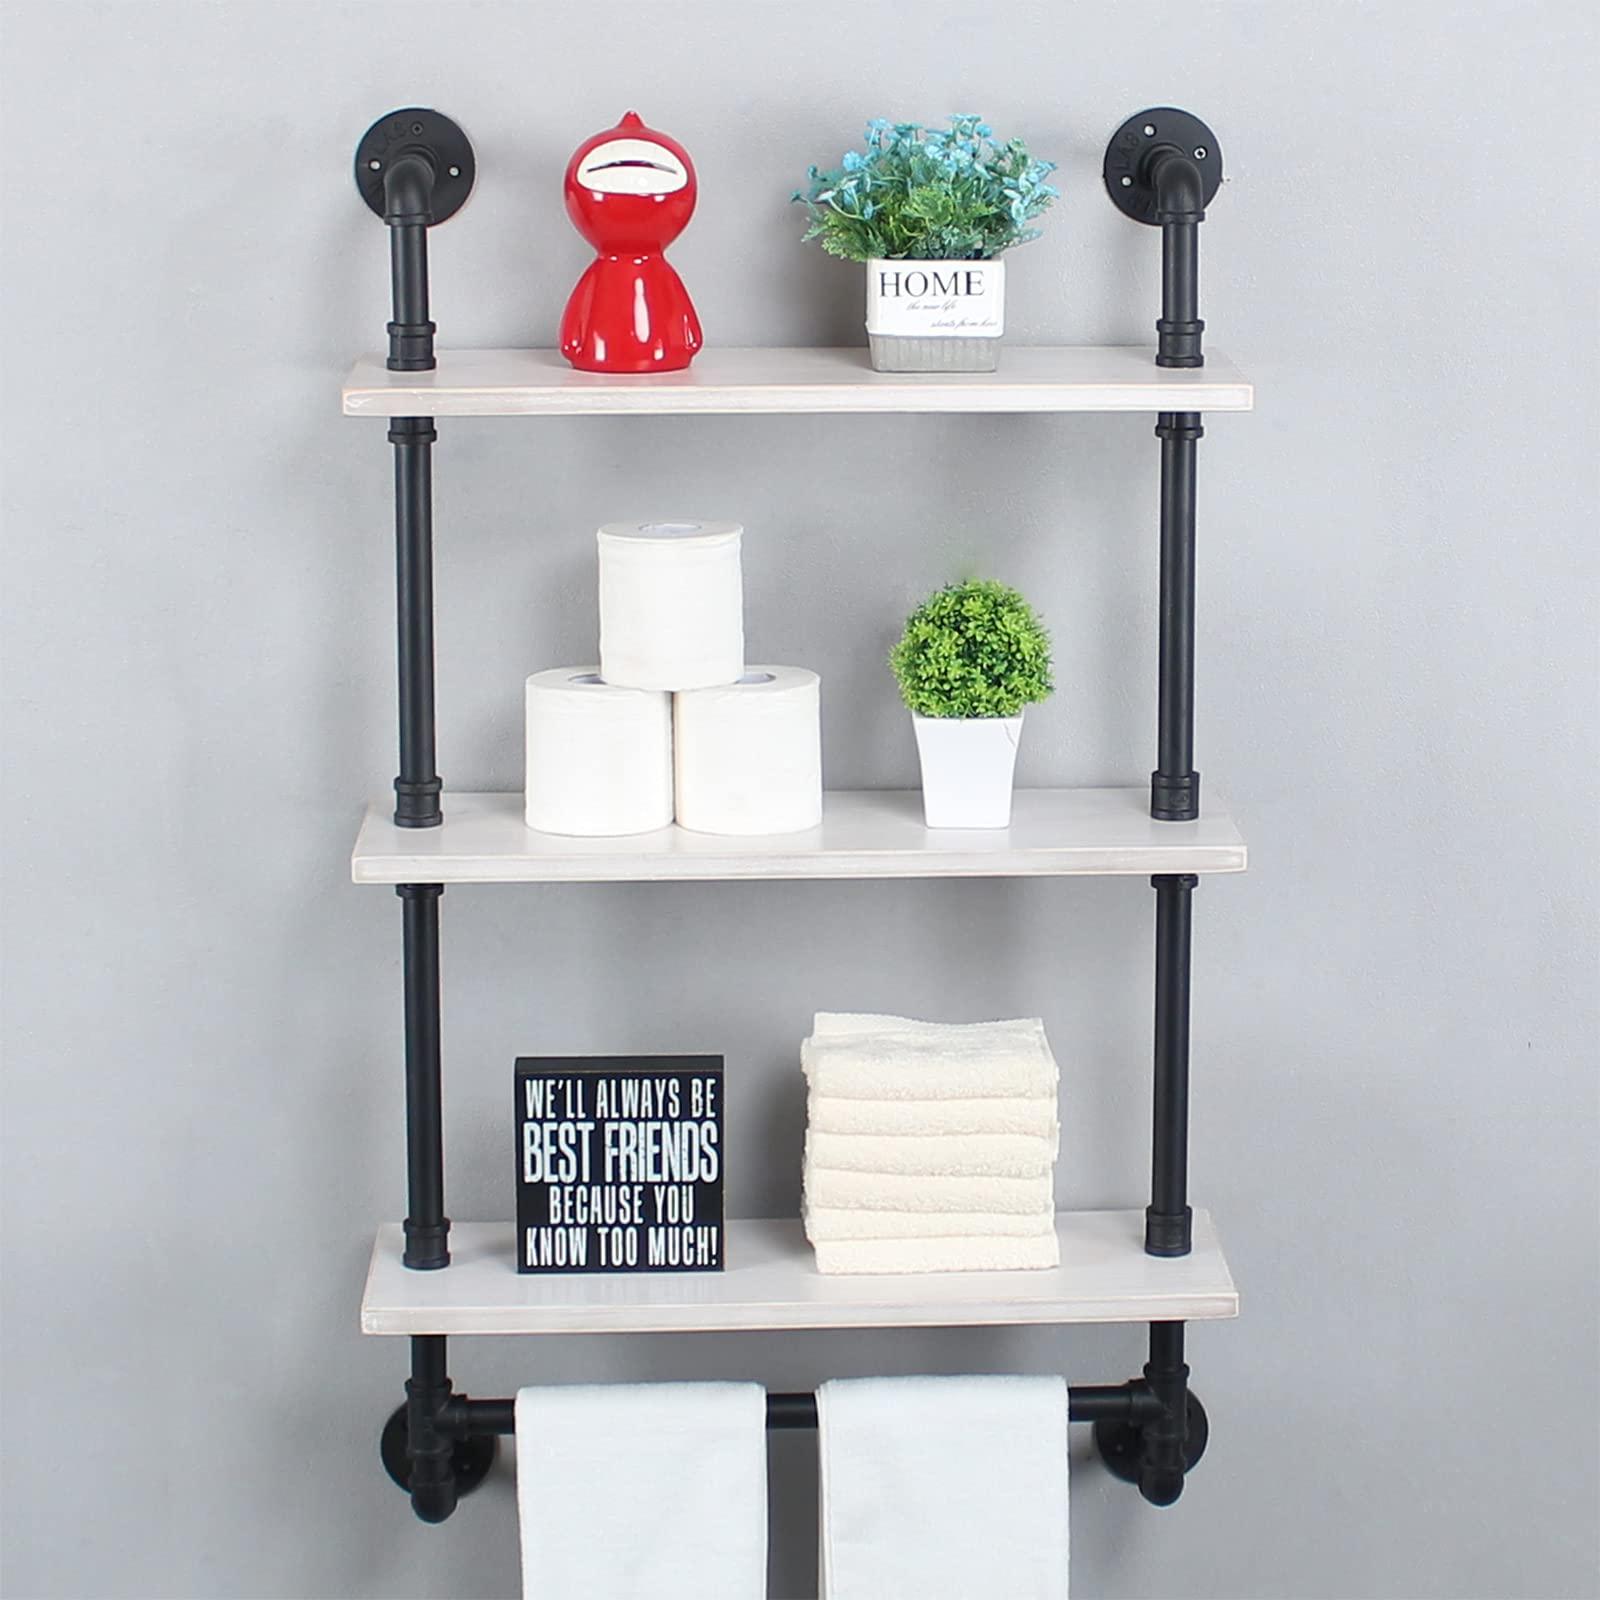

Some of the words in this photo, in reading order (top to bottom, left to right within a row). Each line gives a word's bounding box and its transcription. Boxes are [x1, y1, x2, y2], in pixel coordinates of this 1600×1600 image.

[879, 270, 985, 298] HOME
[524, 1078, 586, 1119] WE'LL
[596, 1078, 680, 1119] ALWAYS
[691, 1078, 716, 1118] BE
[523, 1121, 595, 1183] BEST
[605, 1120, 719, 1183] FRIENDS
[549, 1185, 644, 1225] BECAUSE
[654, 1184, 694, 1224] YOU
[526, 1227, 588, 1267] KNOW
[597, 1226, 637, 1266] TOO
[648, 1226, 718, 1266] MUCH!
